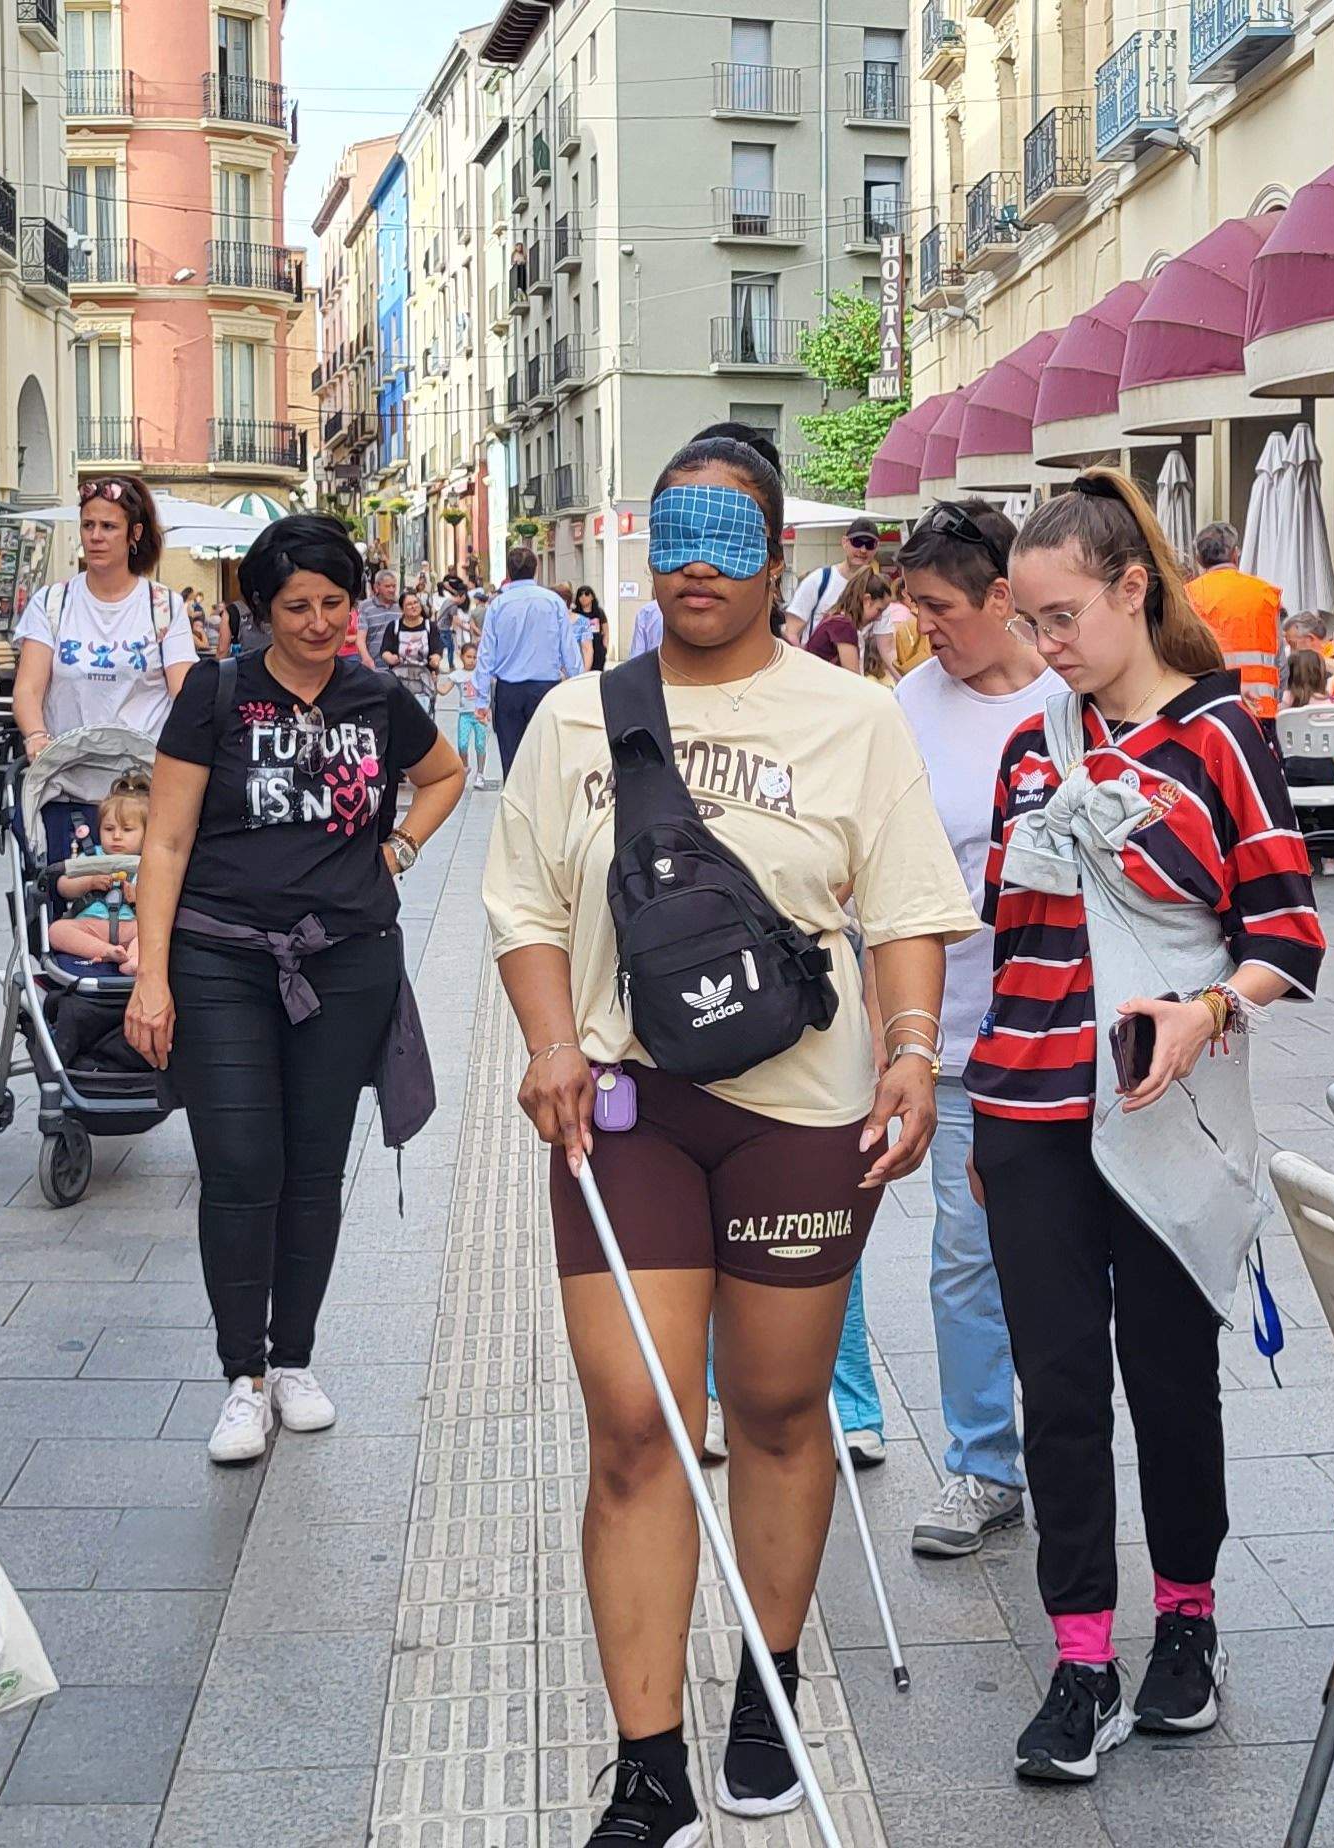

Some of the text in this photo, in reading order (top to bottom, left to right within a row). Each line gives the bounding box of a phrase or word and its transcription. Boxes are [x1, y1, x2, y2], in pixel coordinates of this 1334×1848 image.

[881, 237, 900, 371] HOSTAL
[87, 673, 117, 682] STITCH
[251, 777, 290, 818] IS
[692, 1001, 744, 1028] adidas
[727, 1208, 852, 1242] CALIFORNIA
